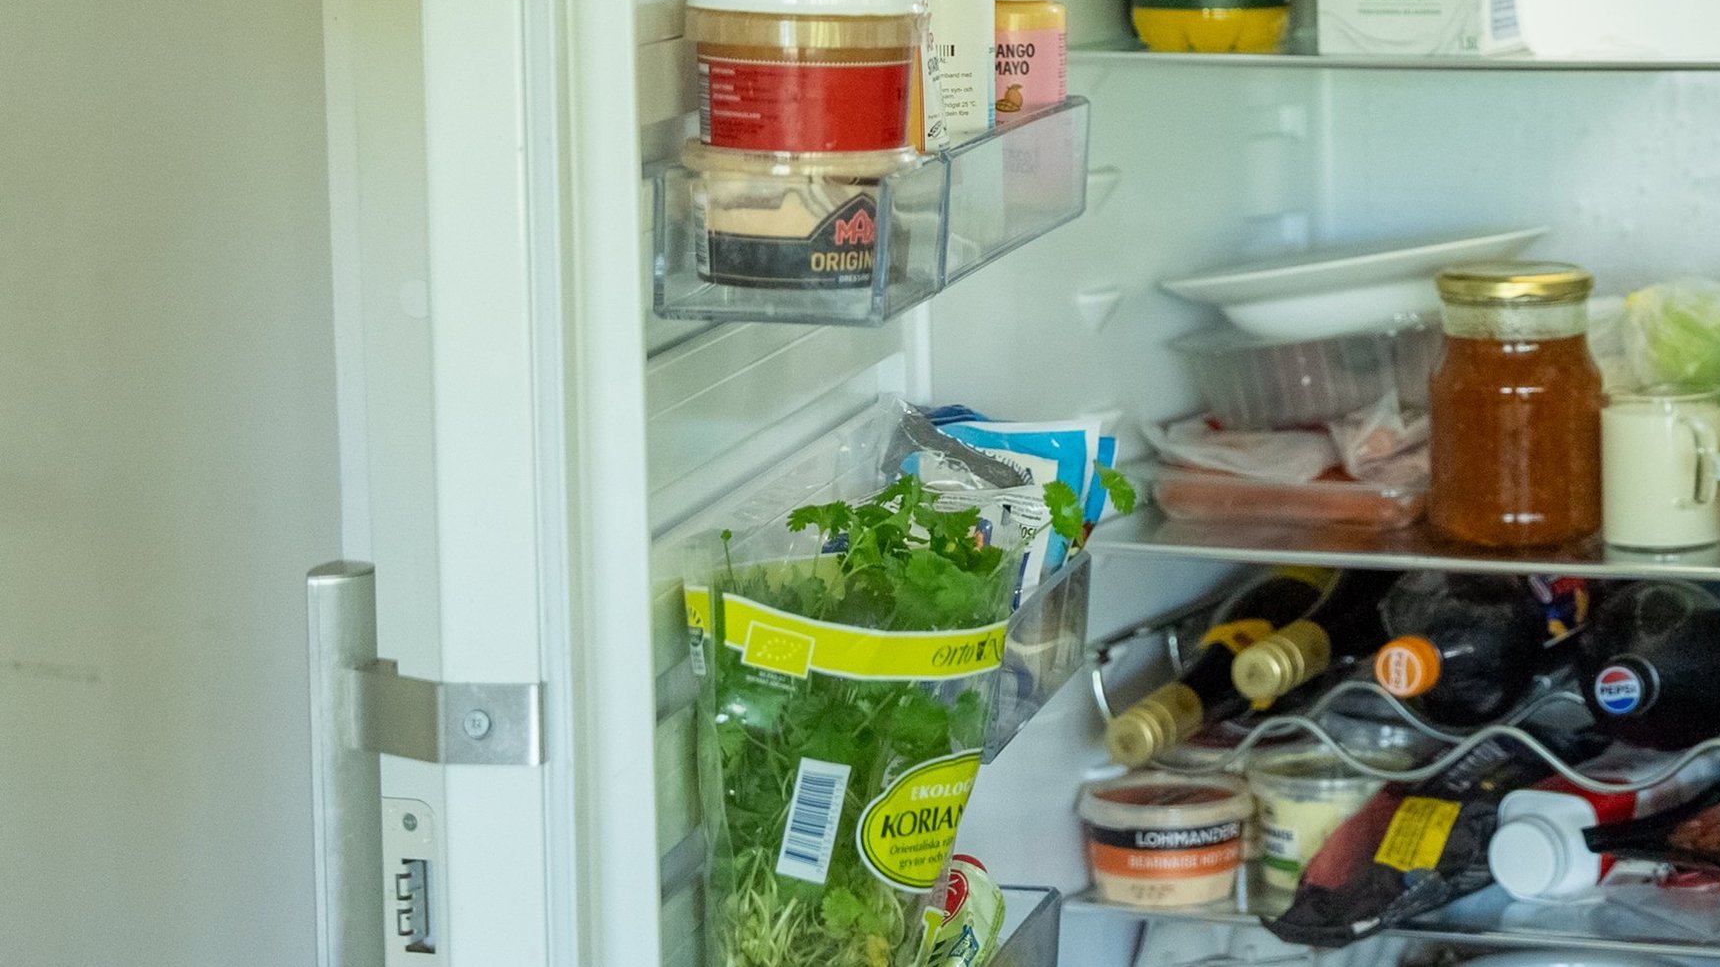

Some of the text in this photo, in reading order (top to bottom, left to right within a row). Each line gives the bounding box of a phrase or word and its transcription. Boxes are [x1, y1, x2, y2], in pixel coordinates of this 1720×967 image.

[996, 43, 1035, 58] ANGO
[1600, 684, 1635, 695] PEPSI
[890, 838, 940, 855] Orientaliska
[899, 851, 943, 870] grytor och
